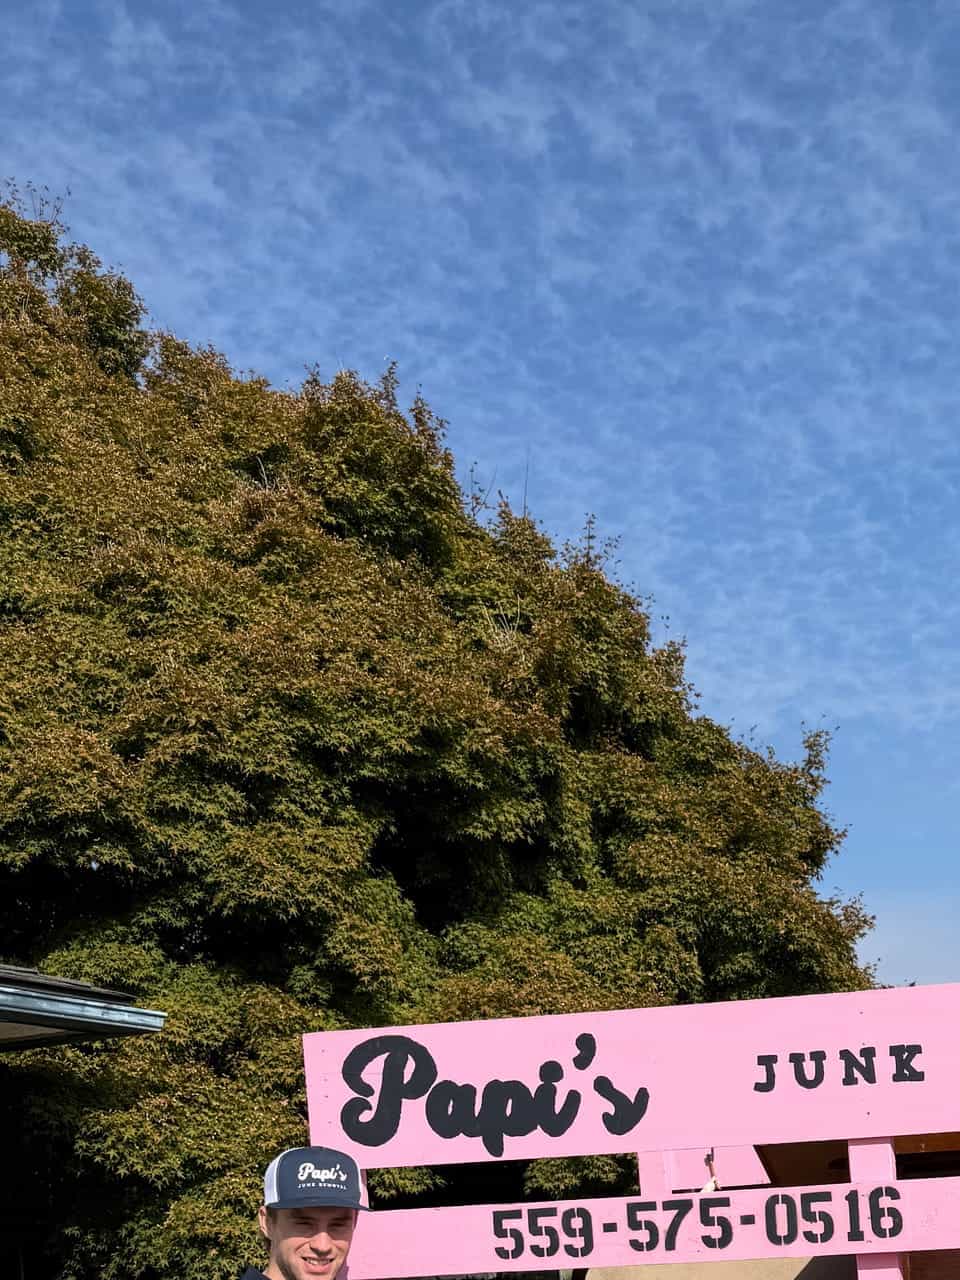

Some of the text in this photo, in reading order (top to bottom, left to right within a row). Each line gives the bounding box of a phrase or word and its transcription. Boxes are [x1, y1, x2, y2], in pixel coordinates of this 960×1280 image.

[340, 1032, 650, 1157] Papi's
[753, 1044, 925, 1093] JUNK
[297, 1162, 348, 1182] Papi's
[492, 1186, 905, 1260] 559-575-0516
